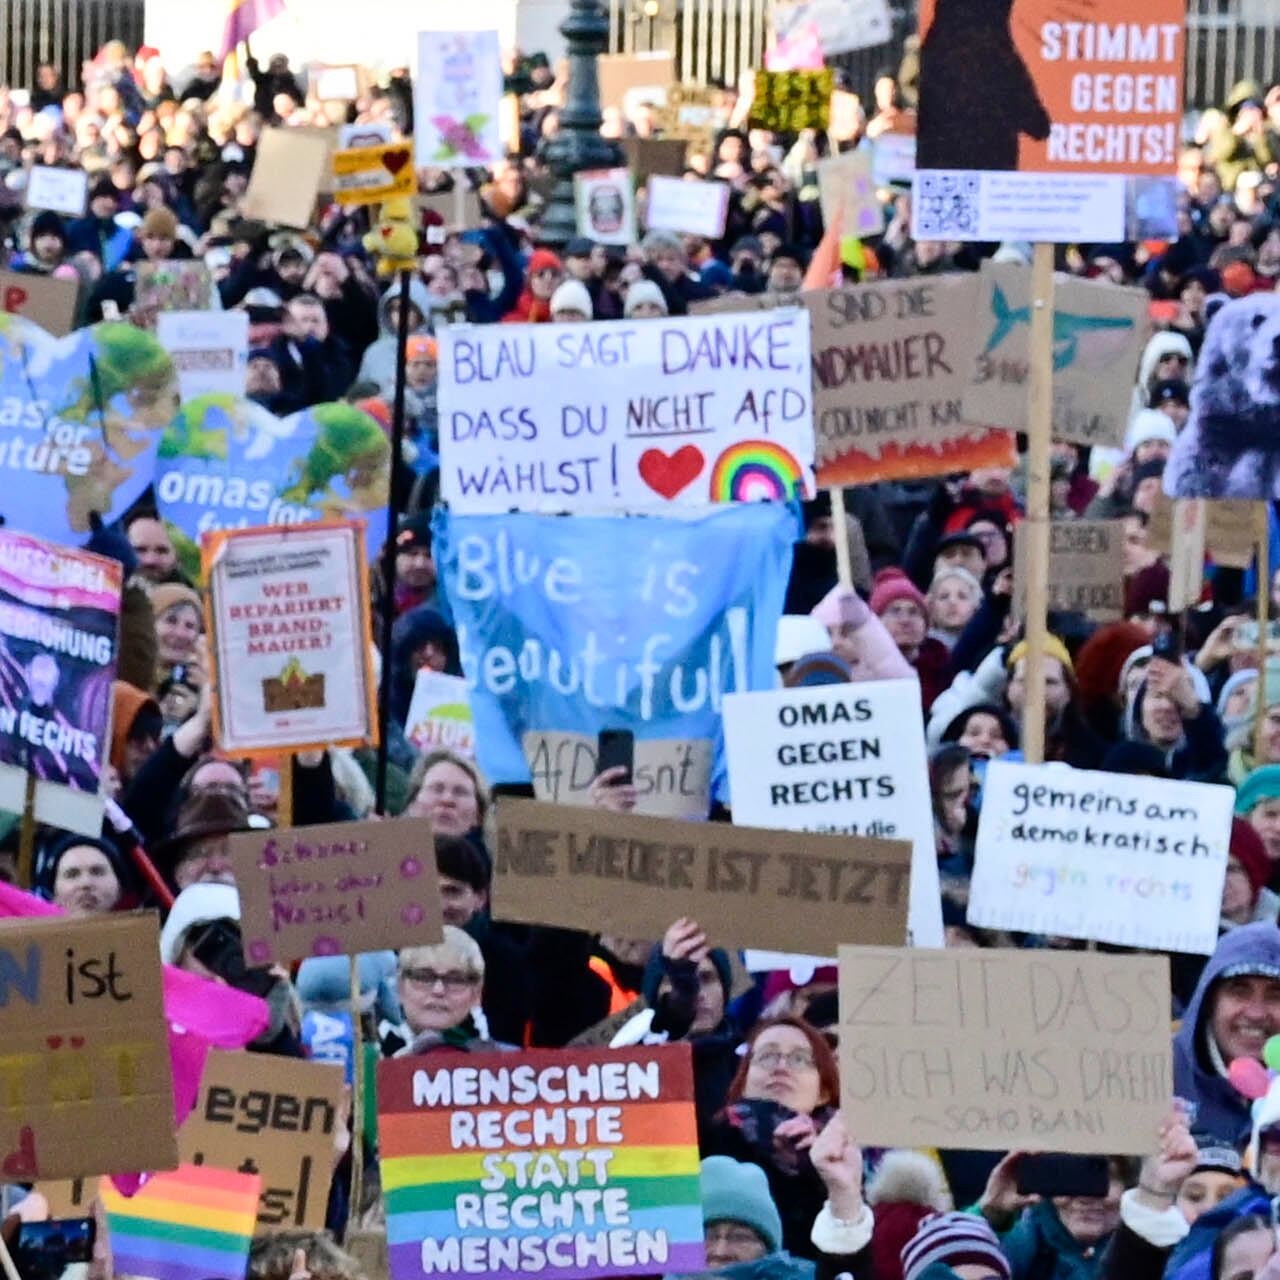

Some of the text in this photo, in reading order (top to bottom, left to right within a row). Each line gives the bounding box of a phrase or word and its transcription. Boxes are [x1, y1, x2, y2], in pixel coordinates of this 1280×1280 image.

[1041, 22, 1180, 62] STIMMT
[1072, 73, 1177, 113] GEGEN
[1047, 124, 1176, 164] RECHTS!
[827, 285, 936, 327] SIND DIE
[453, 319, 805, 384] BLAU SAGT DANKE,
[45, 415, 88, 450] for
[452, 389, 807, 442] DASS DU NICHT AfD
[159, 471, 271, 512] omas
[457, 443, 621, 498] WÄHLST!
[261, 581, 312, 600] WER
[455, 531, 702, 618] Blue is
[229, 596, 345, 623] REPARIERT
[246, 618, 330, 641] BRAND-
[458, 608, 750, 720] beautiful!
[778, 699, 874, 728] OMAS
[776, 738, 882, 767] GEGEN
[769, 775, 897, 808] RECHTS
[1011, 782, 1199, 823] gemeinsam
[1010, 823, 1210, 859] demokratisch
[496, 827, 911, 908] NIE WIEDER IST JETZT
[62, 948, 134, 1004] ist
[1029, 960, 1164, 1036] DASS
[411, 1060, 661, 1108] MENSCHEN
[848, 1044, 954, 1101] SICH
[981, 1045, 1062, 1101] WAS
[204, 1084, 336, 1135] egen
[449, 1106, 624, 1150] RECHTE
[478, 1148, 616, 1191] STATT
[454, 1187, 630, 1230] RECHTE
[420, 1228, 670, 1275] MENSCHEN
